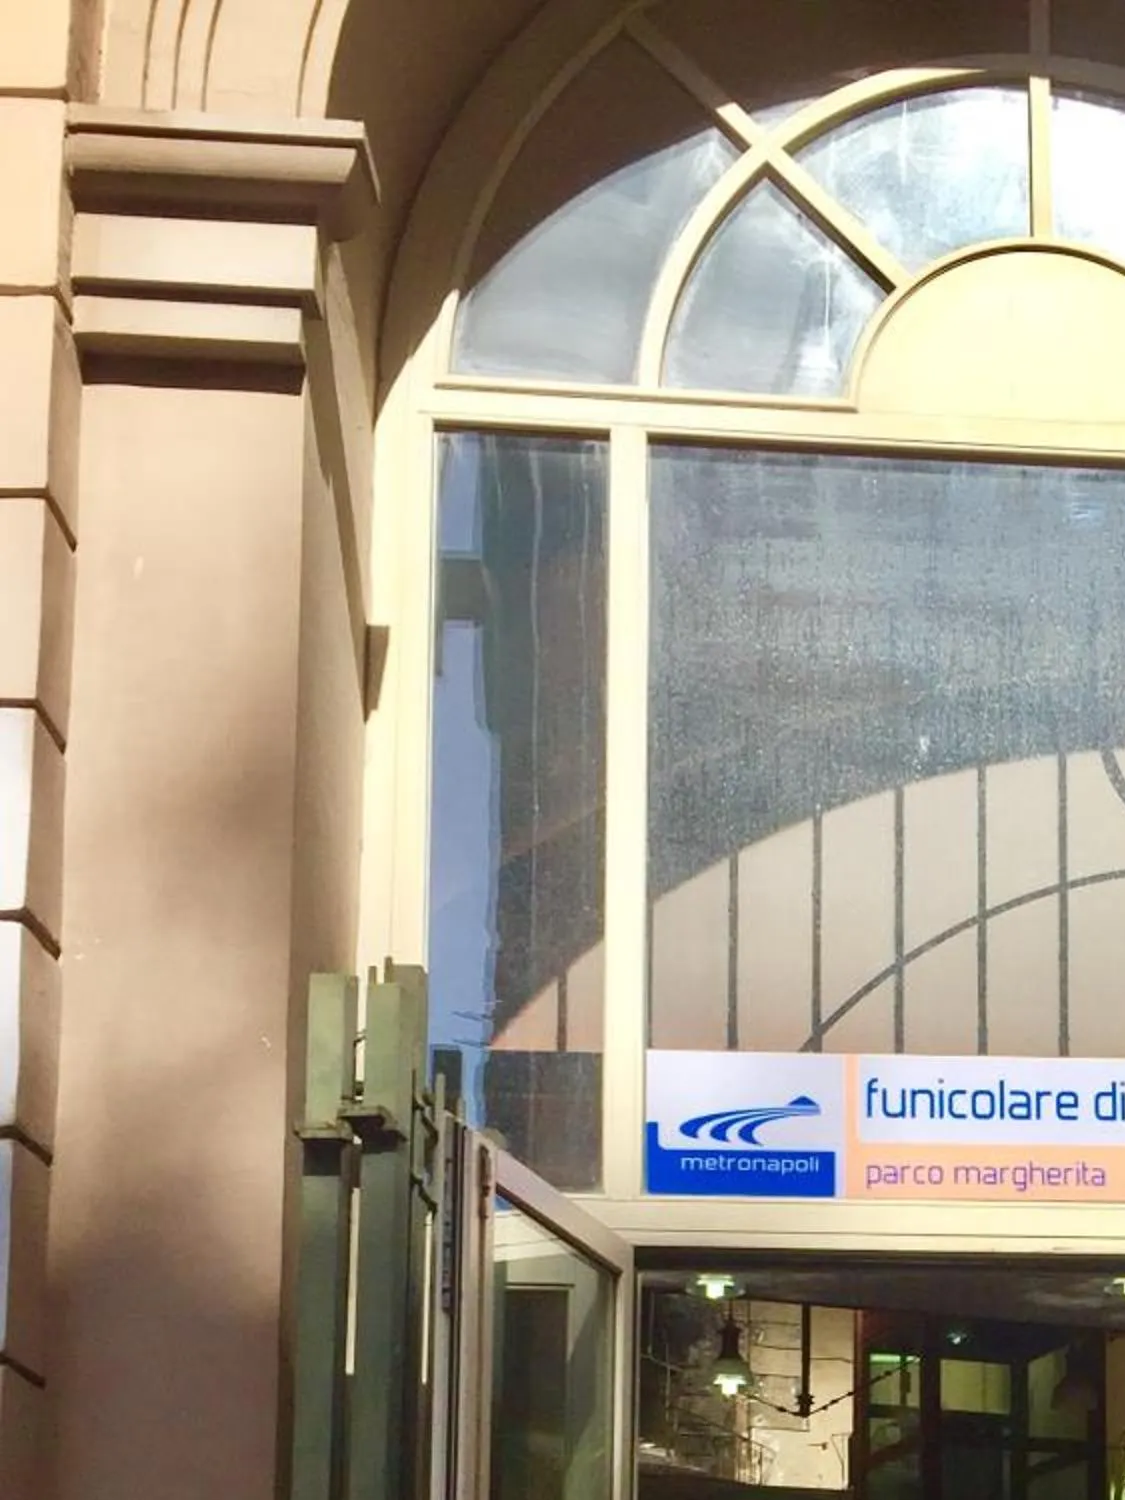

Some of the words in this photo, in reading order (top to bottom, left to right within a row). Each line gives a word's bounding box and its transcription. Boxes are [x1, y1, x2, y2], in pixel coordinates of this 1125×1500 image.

[866, 1077, 1079, 1121] funicolare
[680, 1154, 820, 1175] metronapoli
[865, 1163, 944, 1189] parco
[953, 1160, 1107, 1191] margherita
